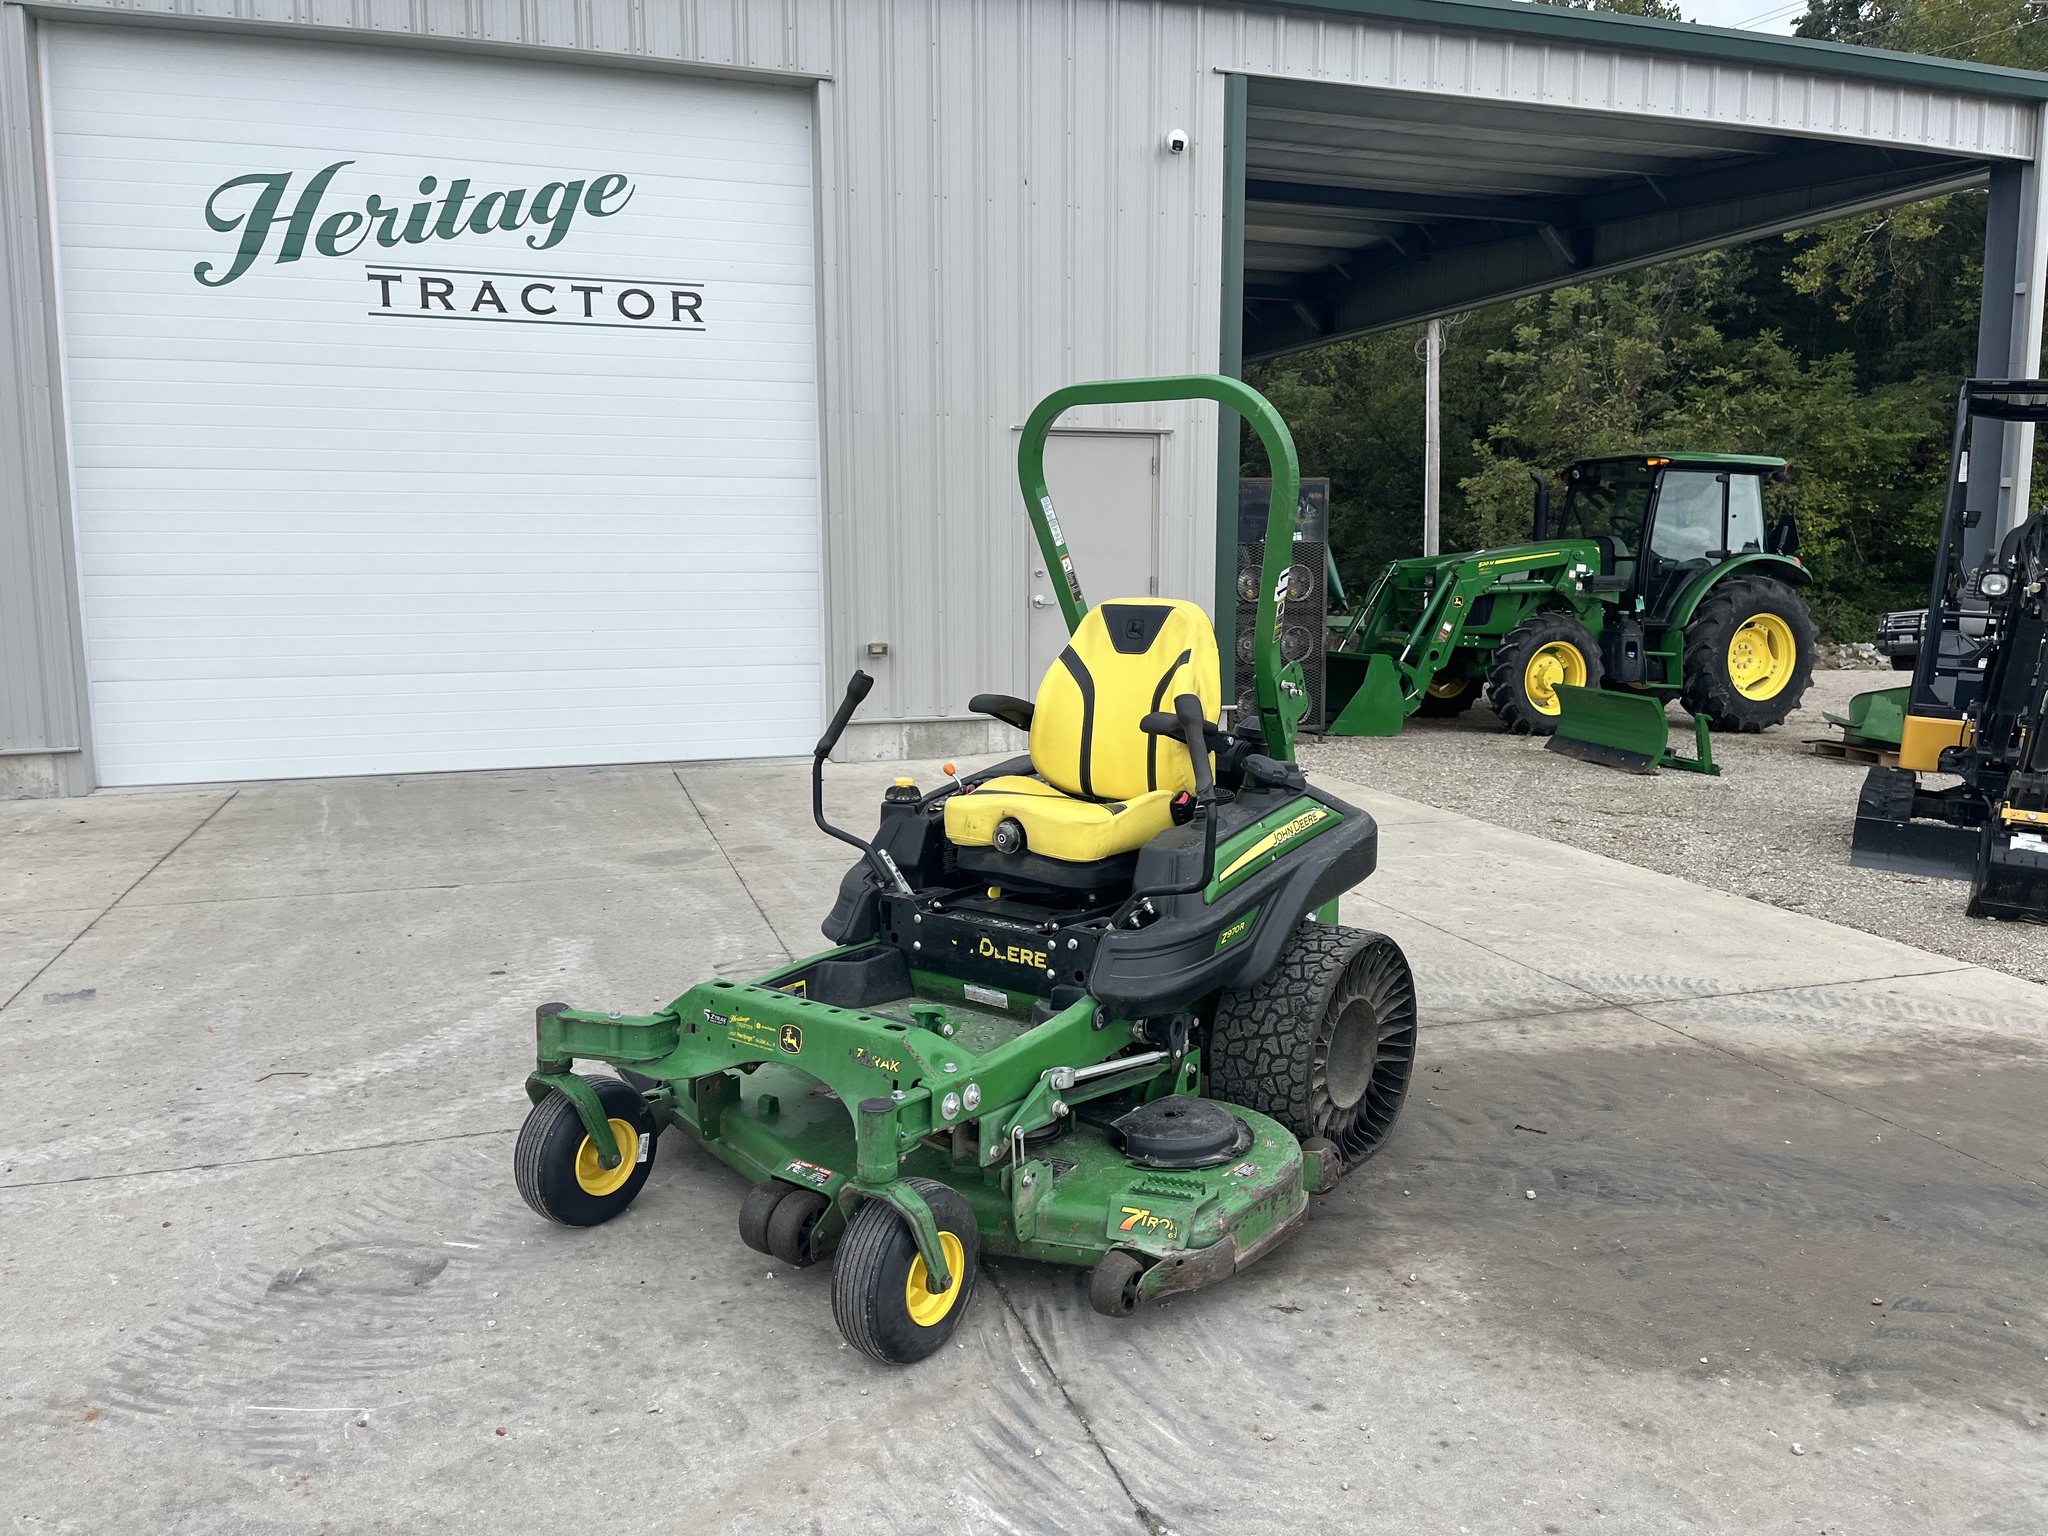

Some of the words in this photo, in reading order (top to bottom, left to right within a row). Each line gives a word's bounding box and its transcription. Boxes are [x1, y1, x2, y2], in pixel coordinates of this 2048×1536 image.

[194, 161, 635, 287] Heritage
[367, 273, 704, 323] TRACTOR
[1273, 826, 1294, 846] JOHN
[1292, 812, 1318, 832] DEERE
[1220, 921, 1245, 945] Z970R
